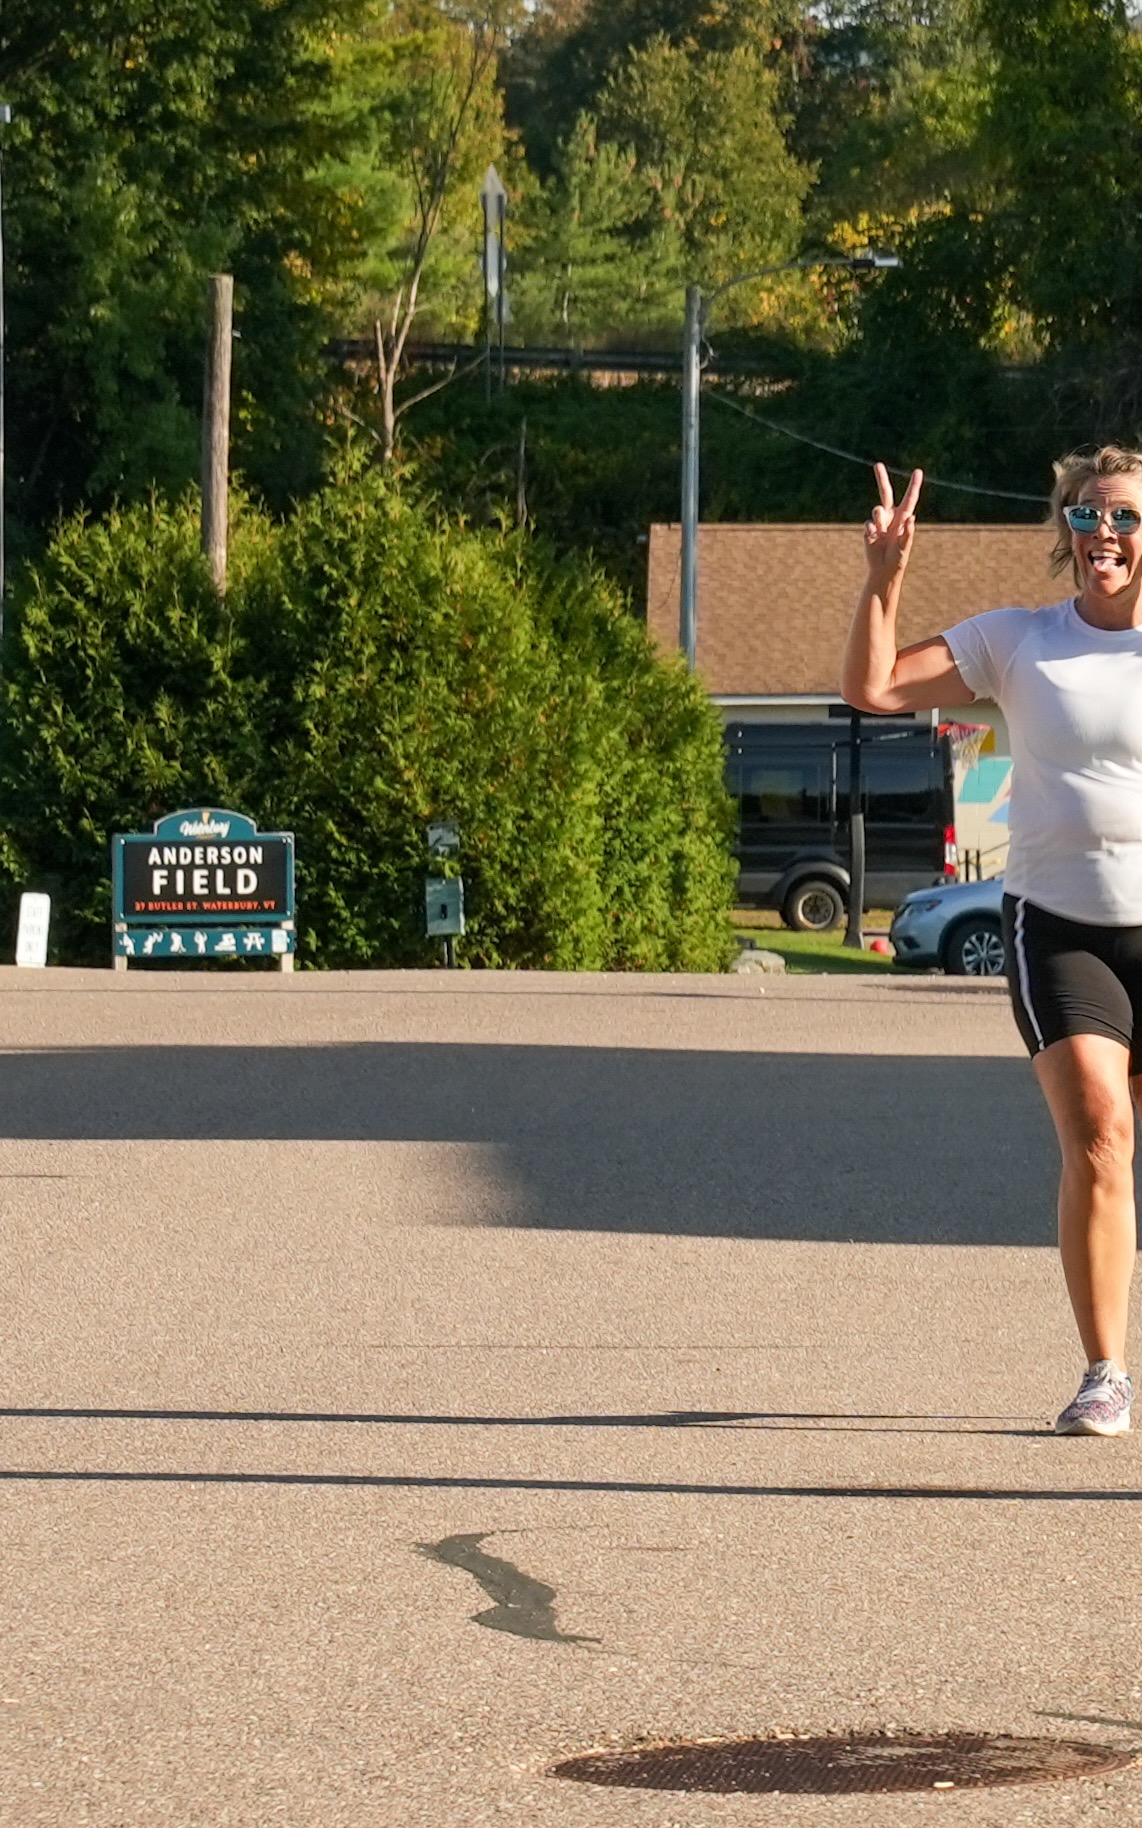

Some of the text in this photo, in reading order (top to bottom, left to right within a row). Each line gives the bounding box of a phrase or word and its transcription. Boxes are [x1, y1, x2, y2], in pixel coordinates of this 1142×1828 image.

[148, 846, 263, 866] ANDERSON
[152, 868, 258, 896] FIELD
[148, 901, 184, 911] BUTLER
[263, 900, 276, 910] VT
